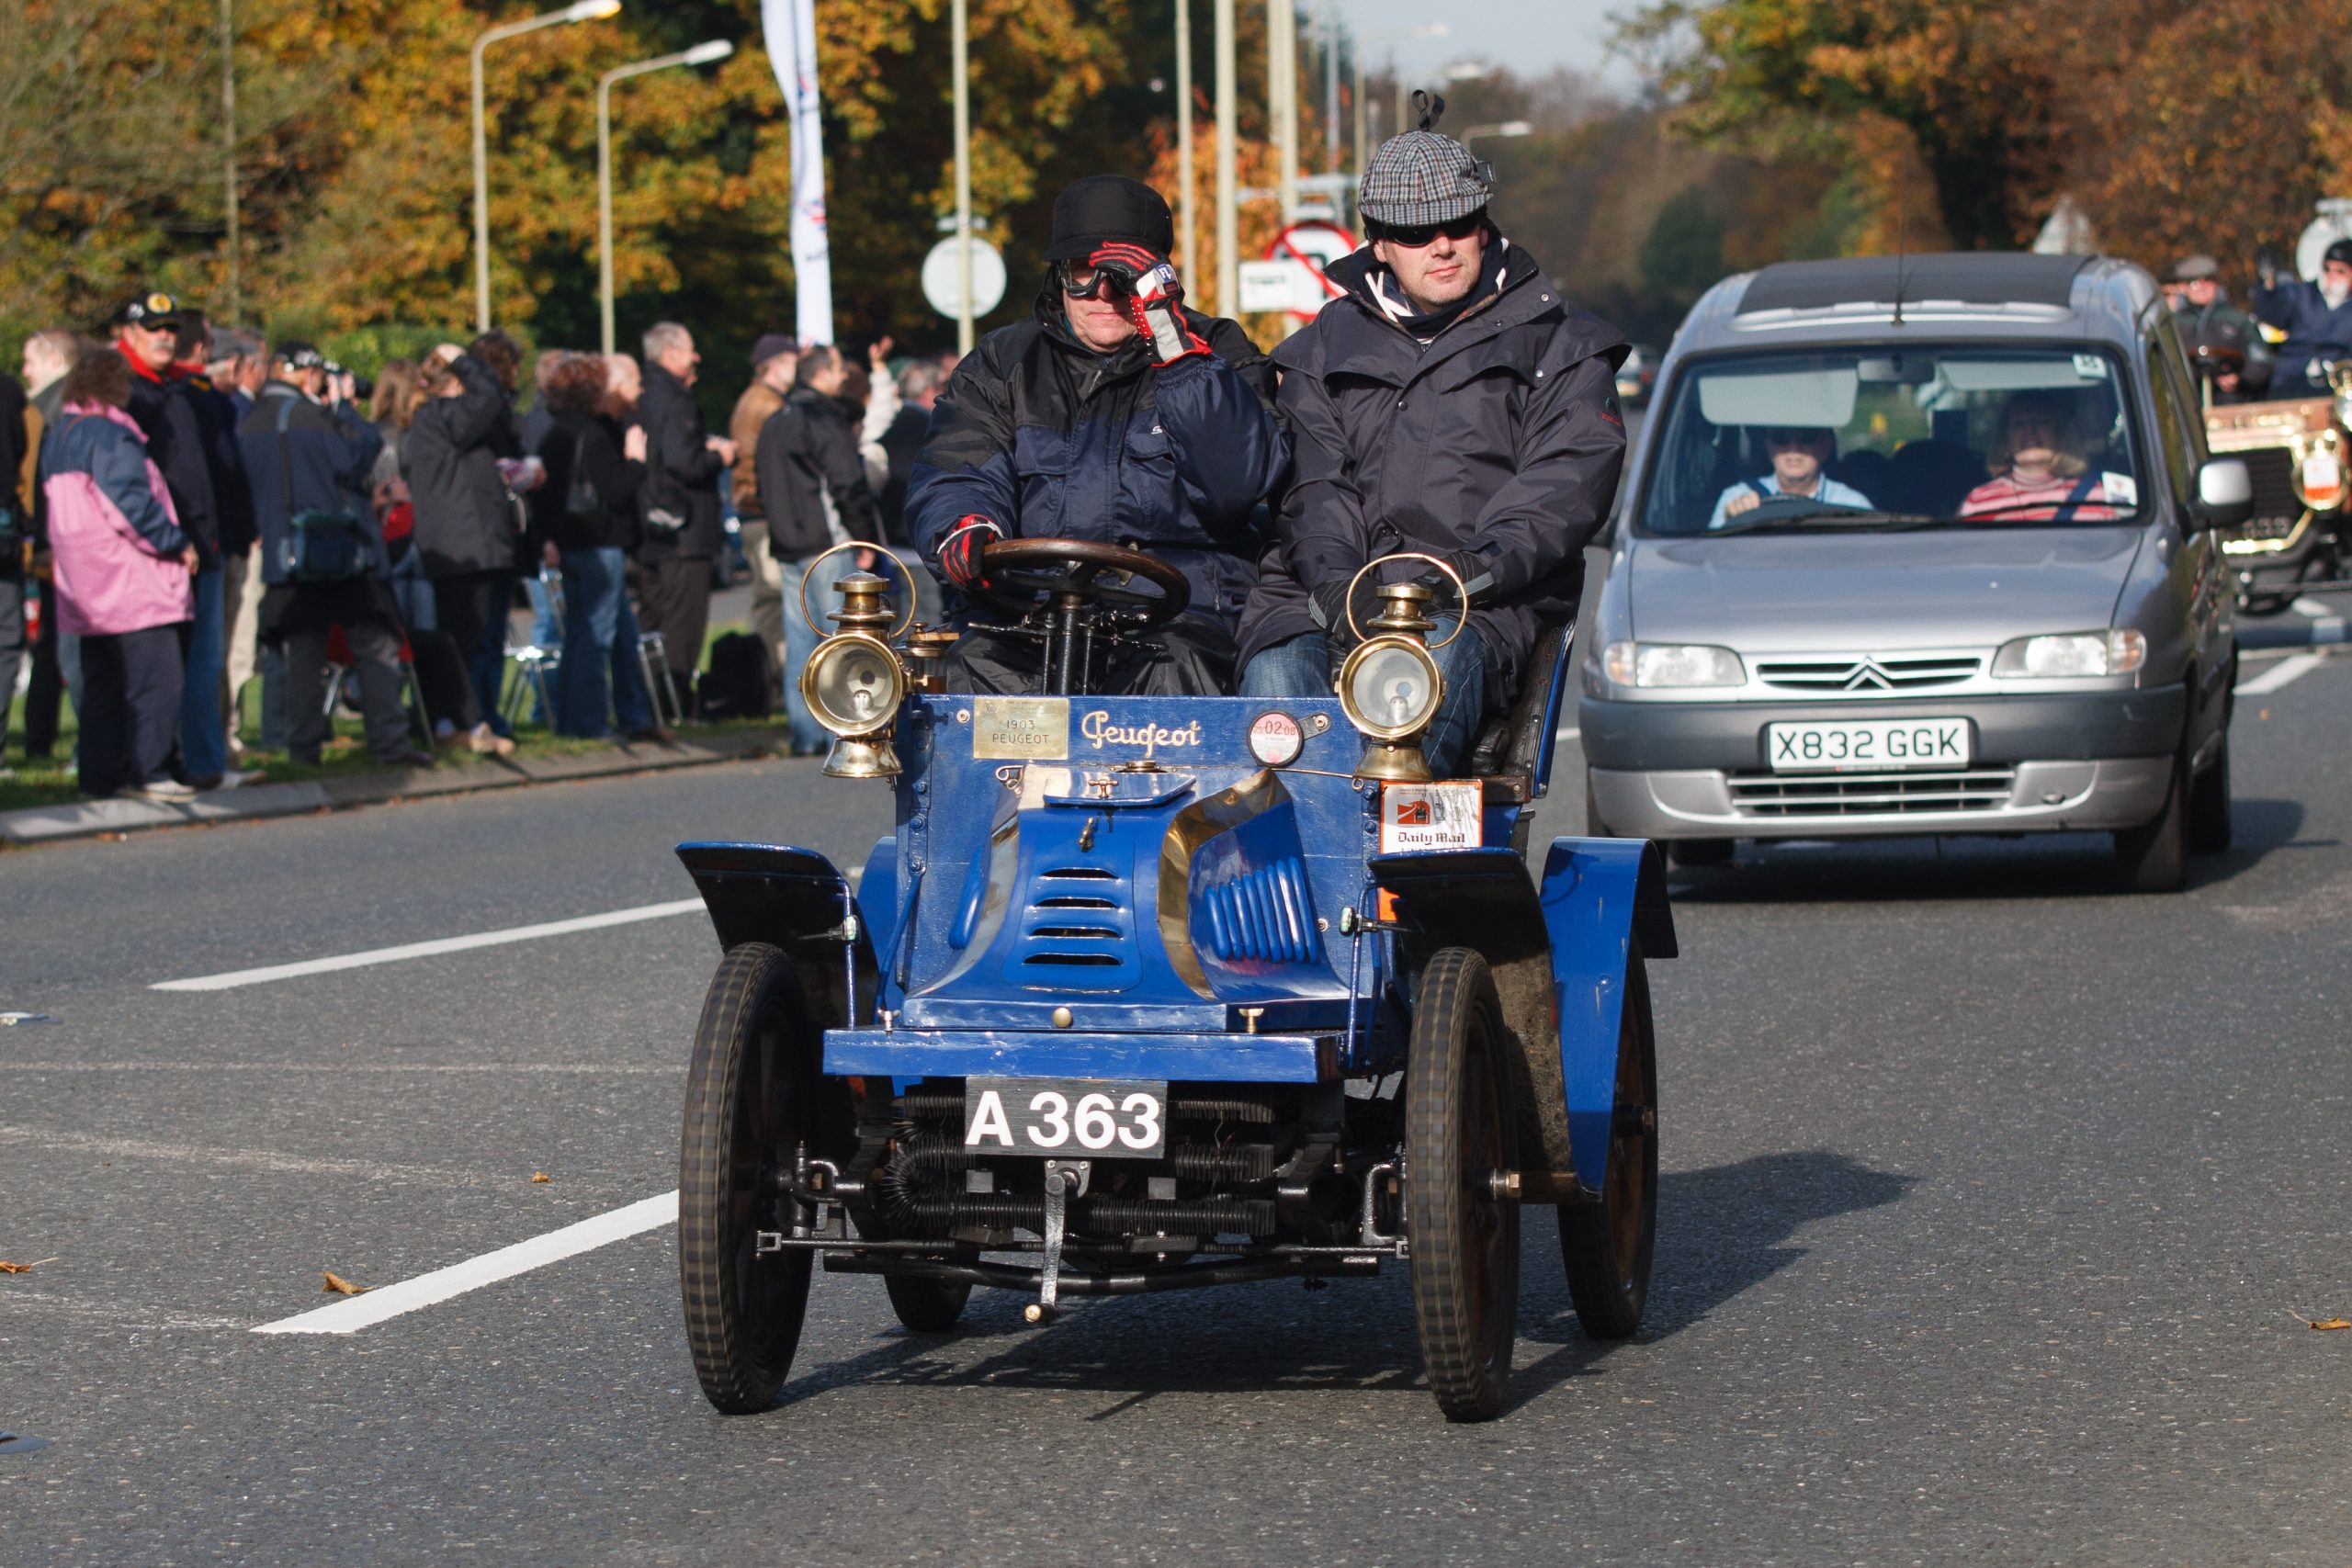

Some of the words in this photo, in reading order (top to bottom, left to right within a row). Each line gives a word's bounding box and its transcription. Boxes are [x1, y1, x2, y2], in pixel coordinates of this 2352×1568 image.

[1007, 719, 1035, 730] 1903
[1265, 721, 1282, 735] 02
[992, 733, 1049, 744] PEUGEOT
[1081, 710, 1201, 759] Peugeot
[1778, 730, 1874, 761] X832
[1887, 728, 1960, 758] GGK
[1398, 831, 1432, 845] Daily
[1435, 832, 1465, 843] Mail
[965, 1090, 1014, 1146] A
[1026, 1091, 1160, 1149] 363
